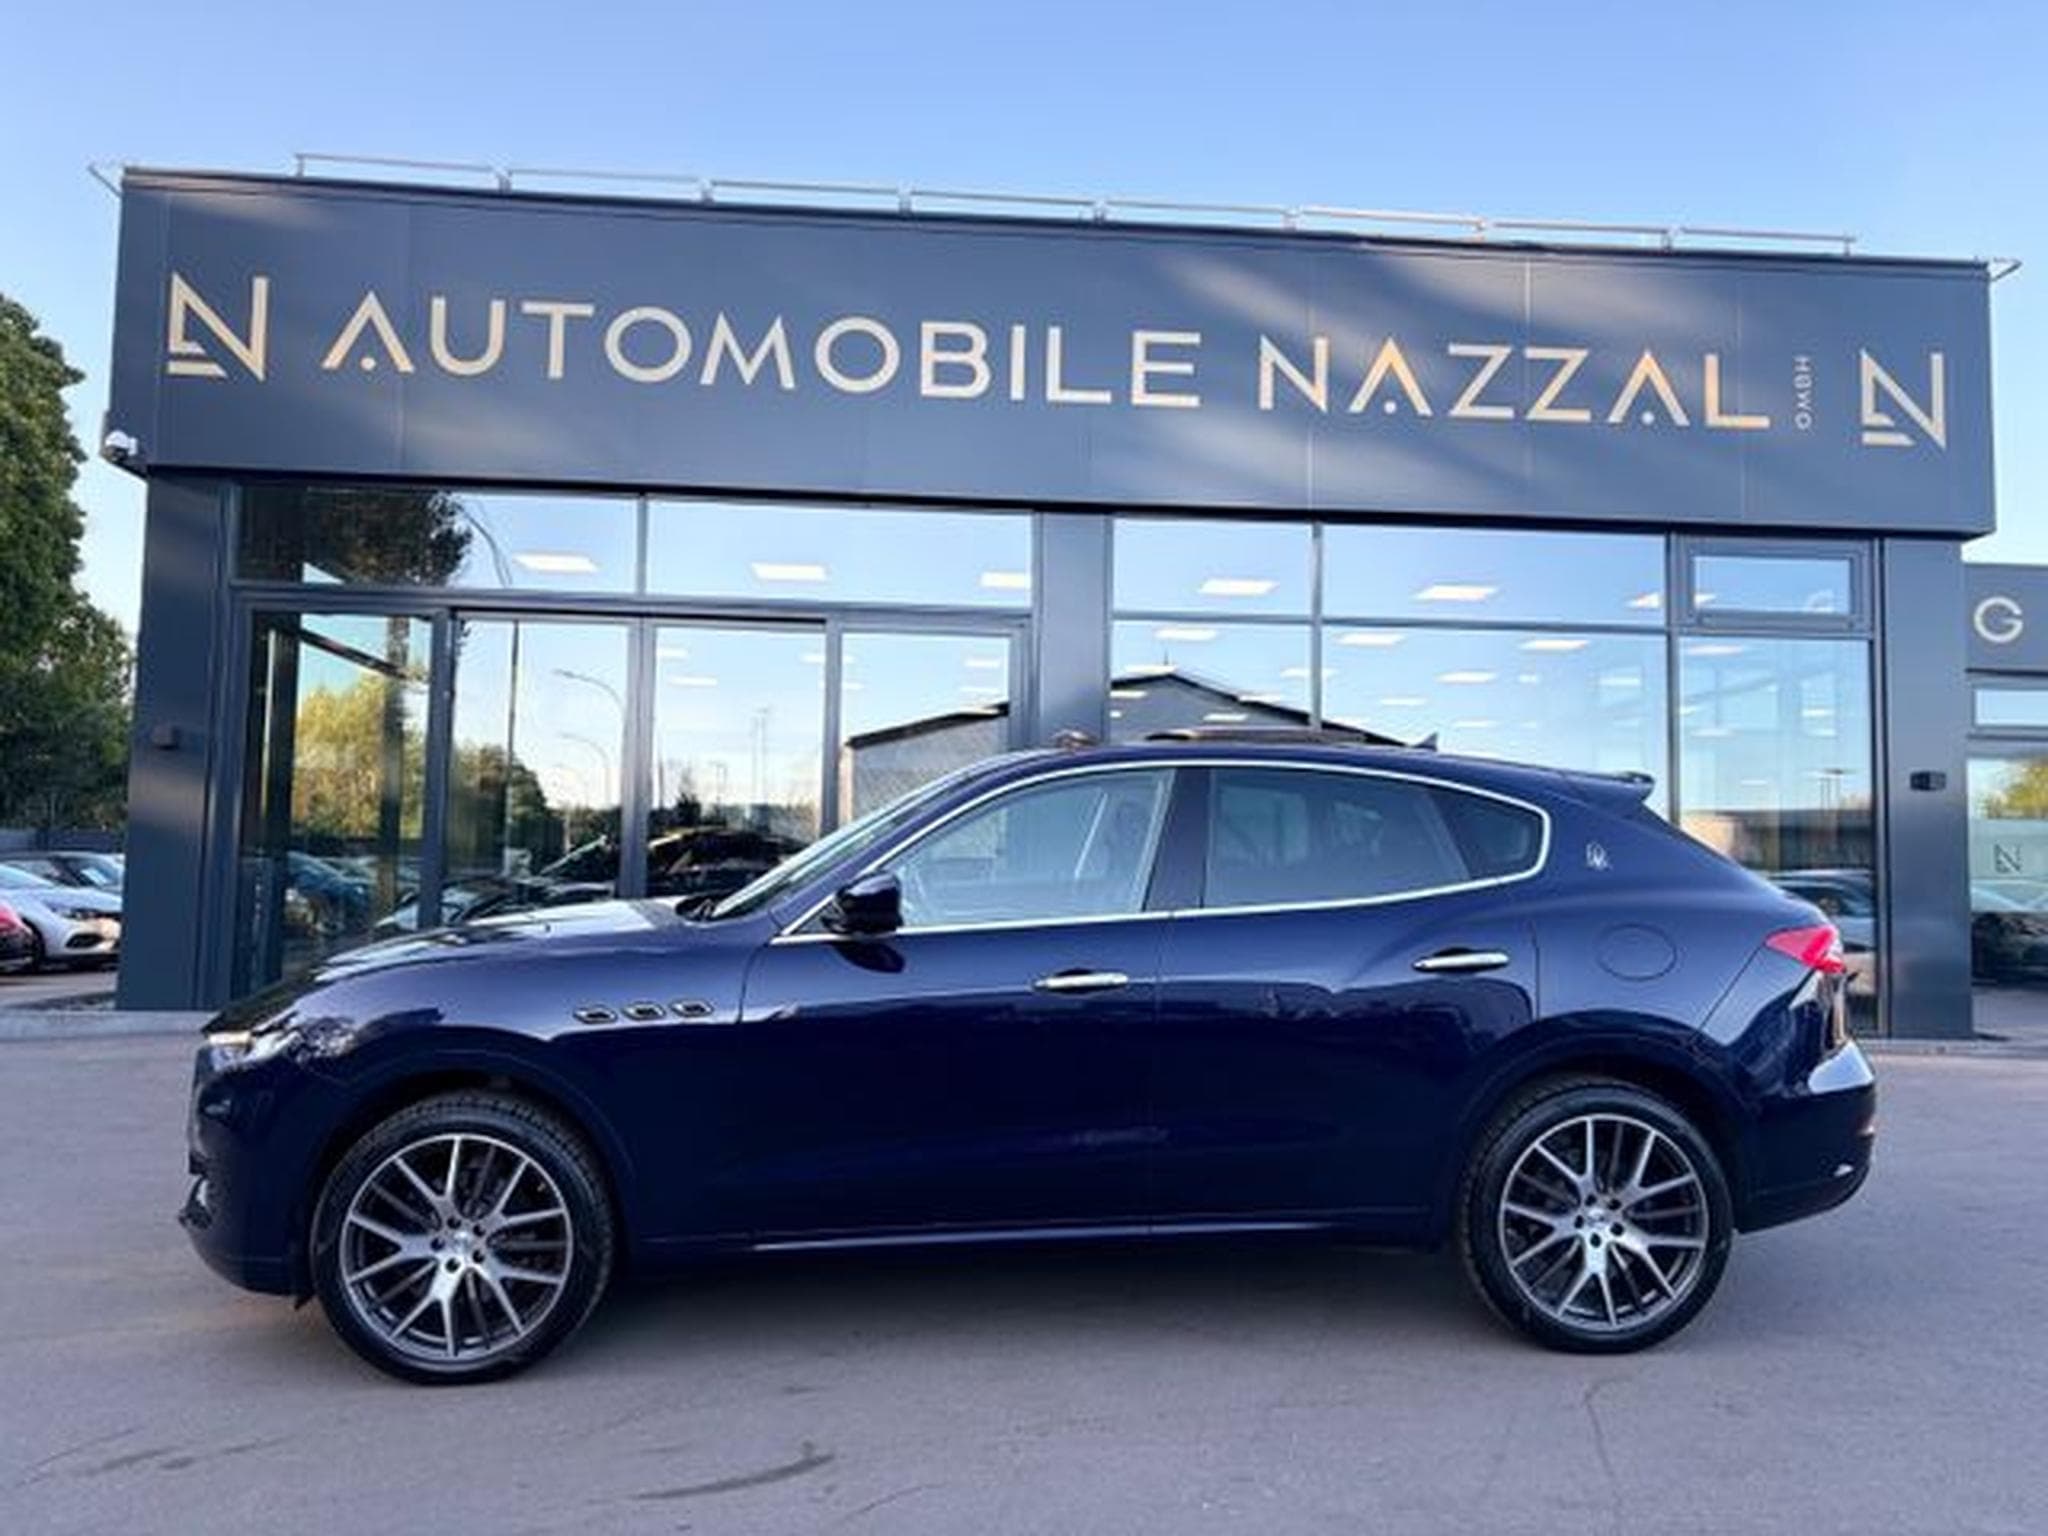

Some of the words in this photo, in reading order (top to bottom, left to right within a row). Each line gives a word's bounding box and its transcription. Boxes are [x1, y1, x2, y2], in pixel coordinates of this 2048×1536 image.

[321, 291, 1201, 409] AUTOMOBILE
[1259, 336, 1770, 428] NAZZAL
[1974, 596, 2023, 643] G
